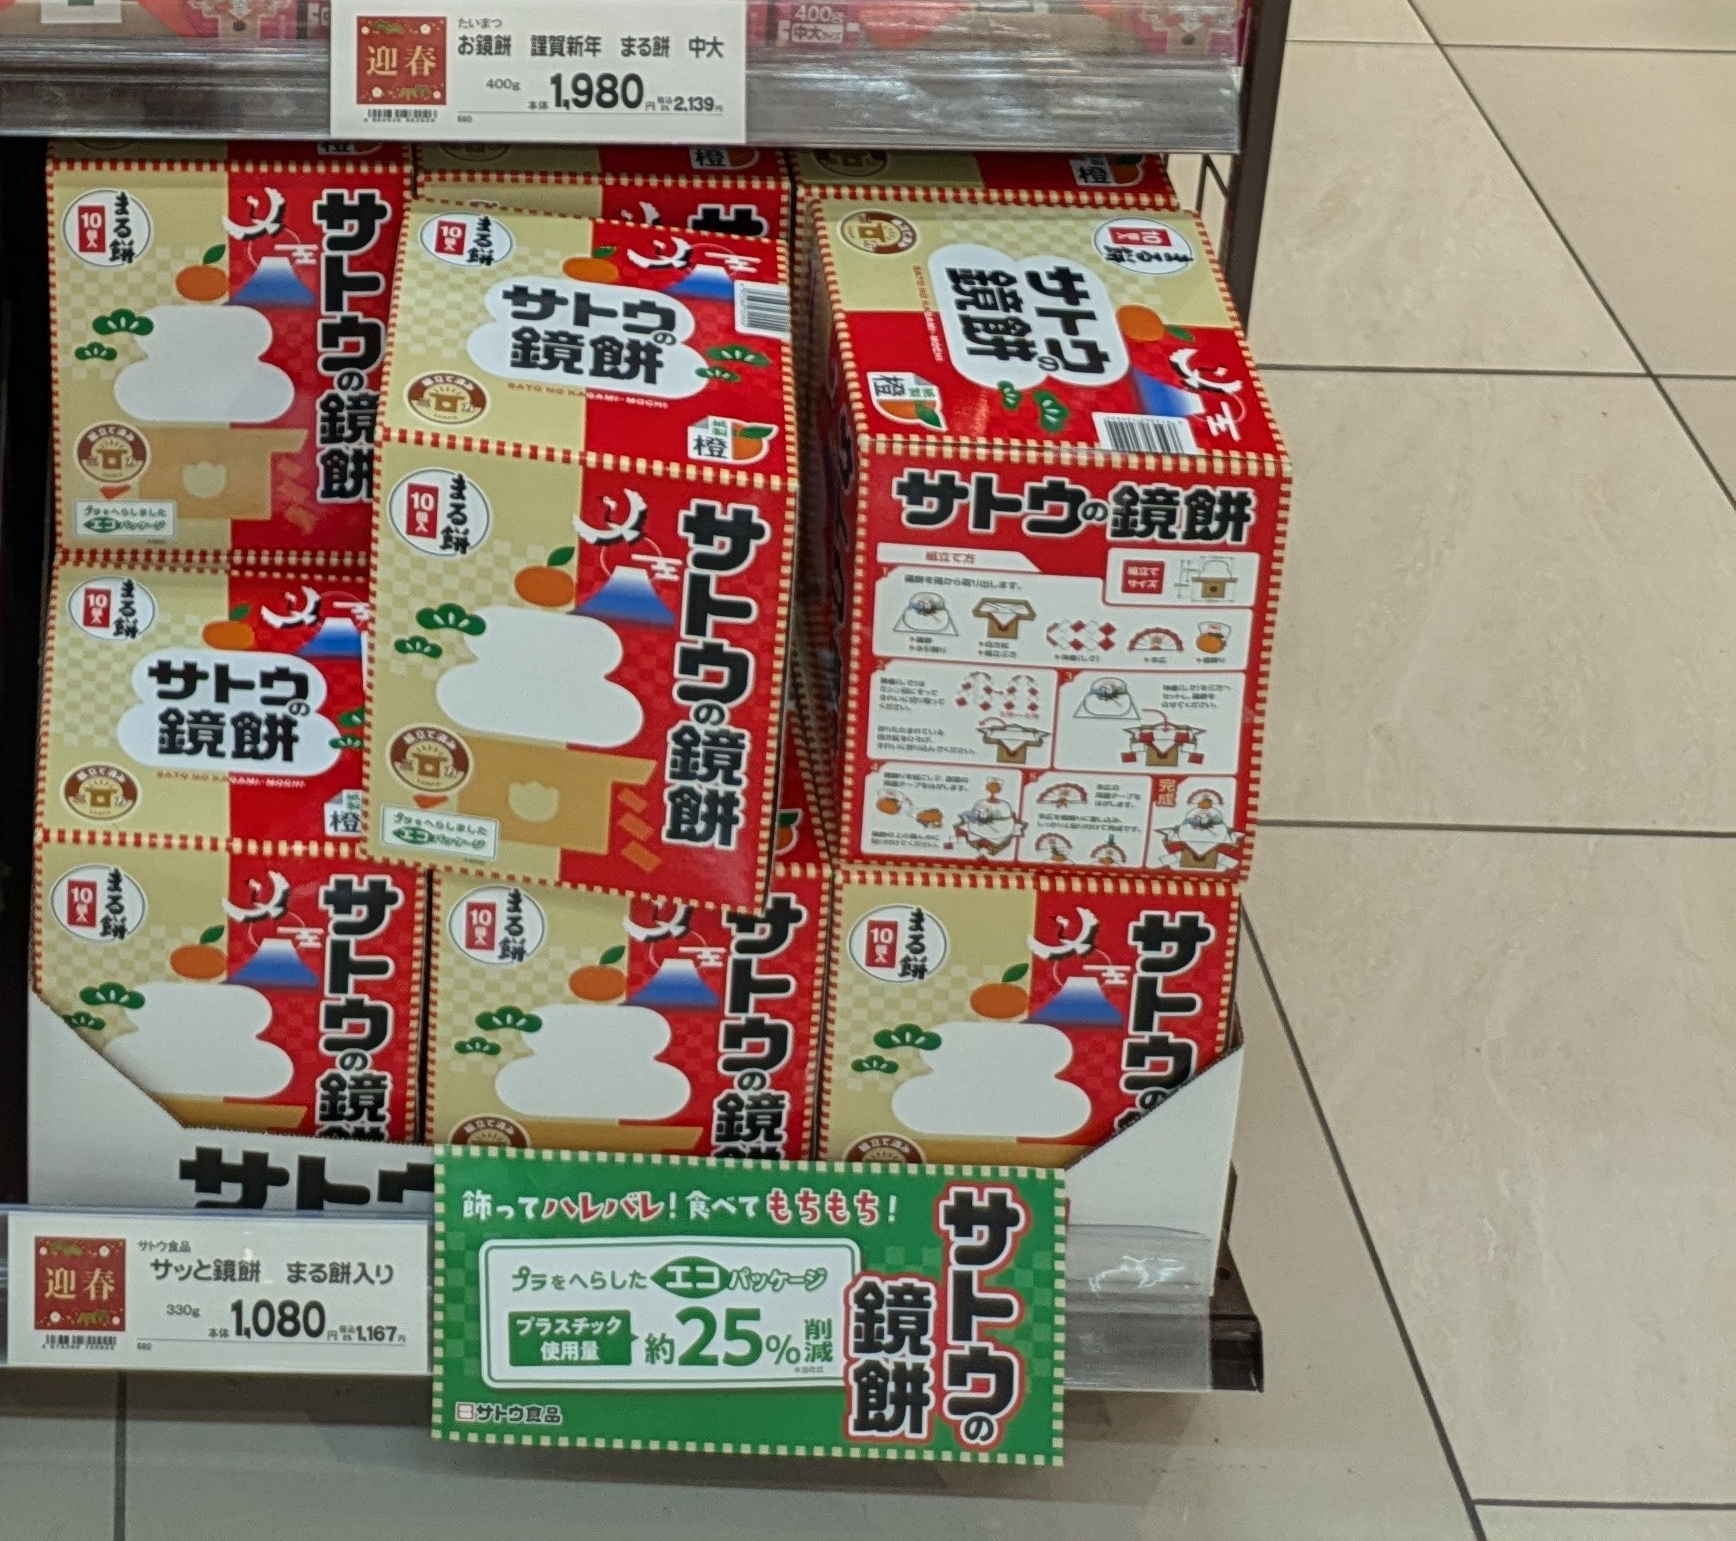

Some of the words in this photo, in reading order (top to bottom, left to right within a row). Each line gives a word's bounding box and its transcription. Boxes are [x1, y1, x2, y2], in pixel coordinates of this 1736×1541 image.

[457, 18, 502, 28] たいまつ
[367, 46, 437, 77] 迎春
[457, 35, 512, 57] お鏡餅
[530, 36, 602, 57] 謹賀新年
[621, 36, 670, 58] まる餅
[688, 36, 724, 58] 中大
[486, 78, 520, 91] 400g
[550, 73, 644, 110] 1,980
[509, 328, 666, 386] 鏡餅
[895, 469, 1255, 544] サトウの鏡餅
[665, 501, 769, 849] サトウの鏡餅
[898, 907, 929, 982] まる餅
[137, 1240, 191, 1252] サトウ食品
[45, 1267, 116, 1301] 迎春
[150, 1259, 261, 1282] サッと鏡餅
[287, 1262, 393, 1284] まる餅入り
[166, 1304, 200, 1317] 330g
[231, 1299, 326, 1339] 1,080
[516, 1315, 622, 1335] プラスチック
[942, 1191, 1022, 1443] サトウの
[541, 1341, 600, 1362] 使用量
[853, 1281, 933, 1438] 鏡餅
[476, 1404, 562, 1425] サトウ食品
